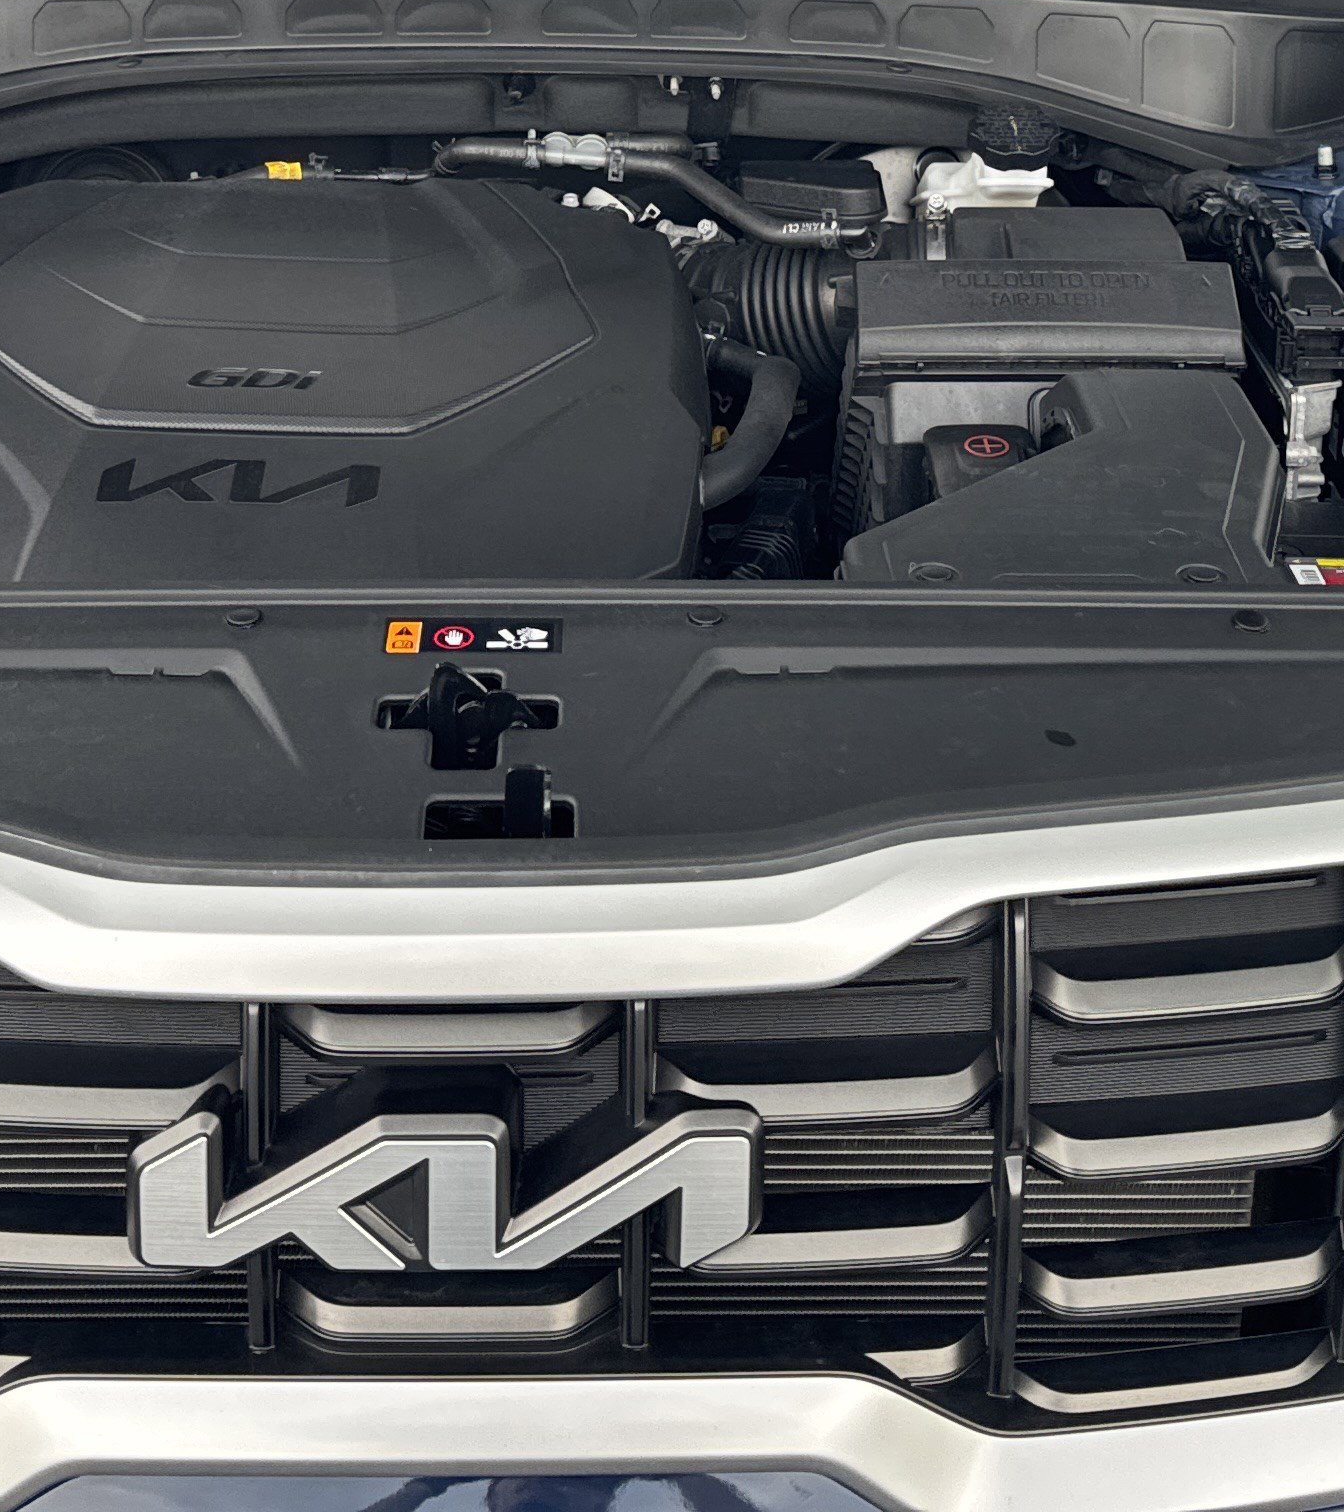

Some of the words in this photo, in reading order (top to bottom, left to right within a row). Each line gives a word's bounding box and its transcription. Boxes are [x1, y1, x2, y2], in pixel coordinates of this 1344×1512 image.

[940, 271, 1000, 288] PULL
[1003, 271, 1049, 288] OUT
[1053, 271, 1084, 288] TO
[187, 367, 323, 389] GDi
[96, 458, 381, 508] KIA
[128, 1108, 763, 1271] KIA
